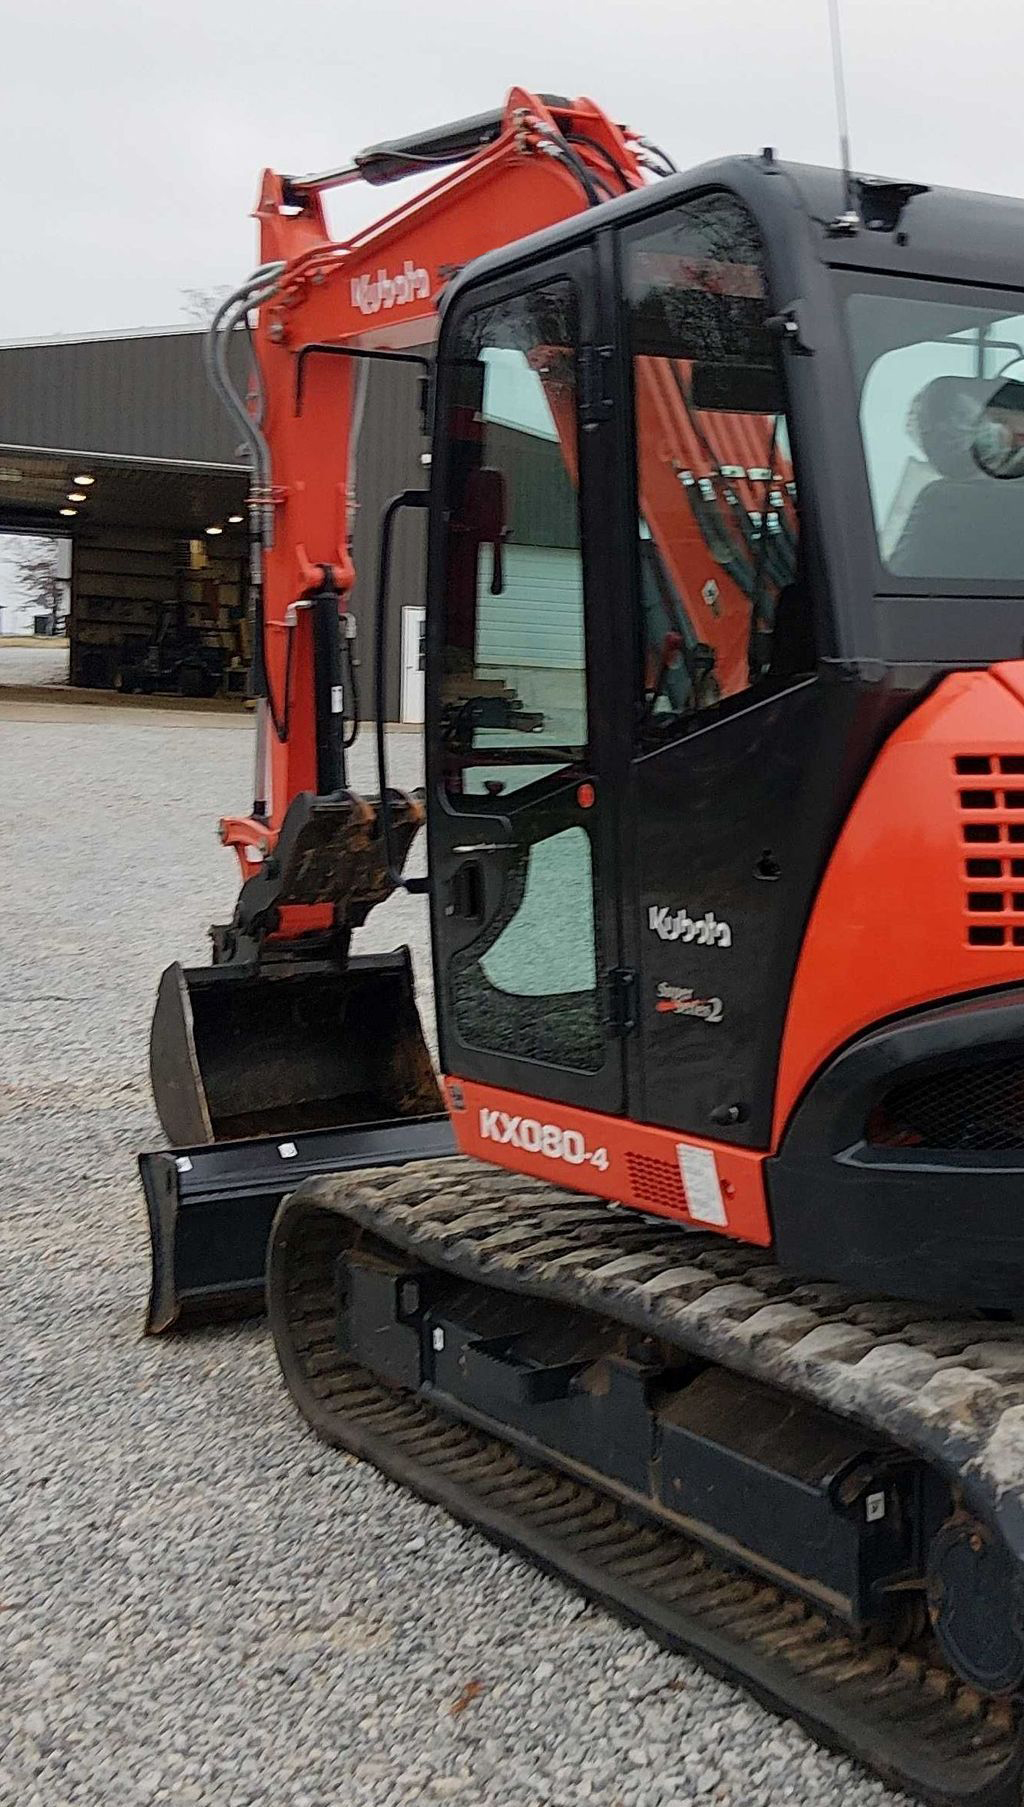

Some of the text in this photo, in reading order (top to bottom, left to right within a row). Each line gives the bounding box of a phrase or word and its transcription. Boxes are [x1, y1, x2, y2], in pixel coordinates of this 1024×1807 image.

[351, 260, 430, 314] Kubota
[648, 905, 732, 948] Kubota
[479, 1107, 610, 1172] KX080-4
